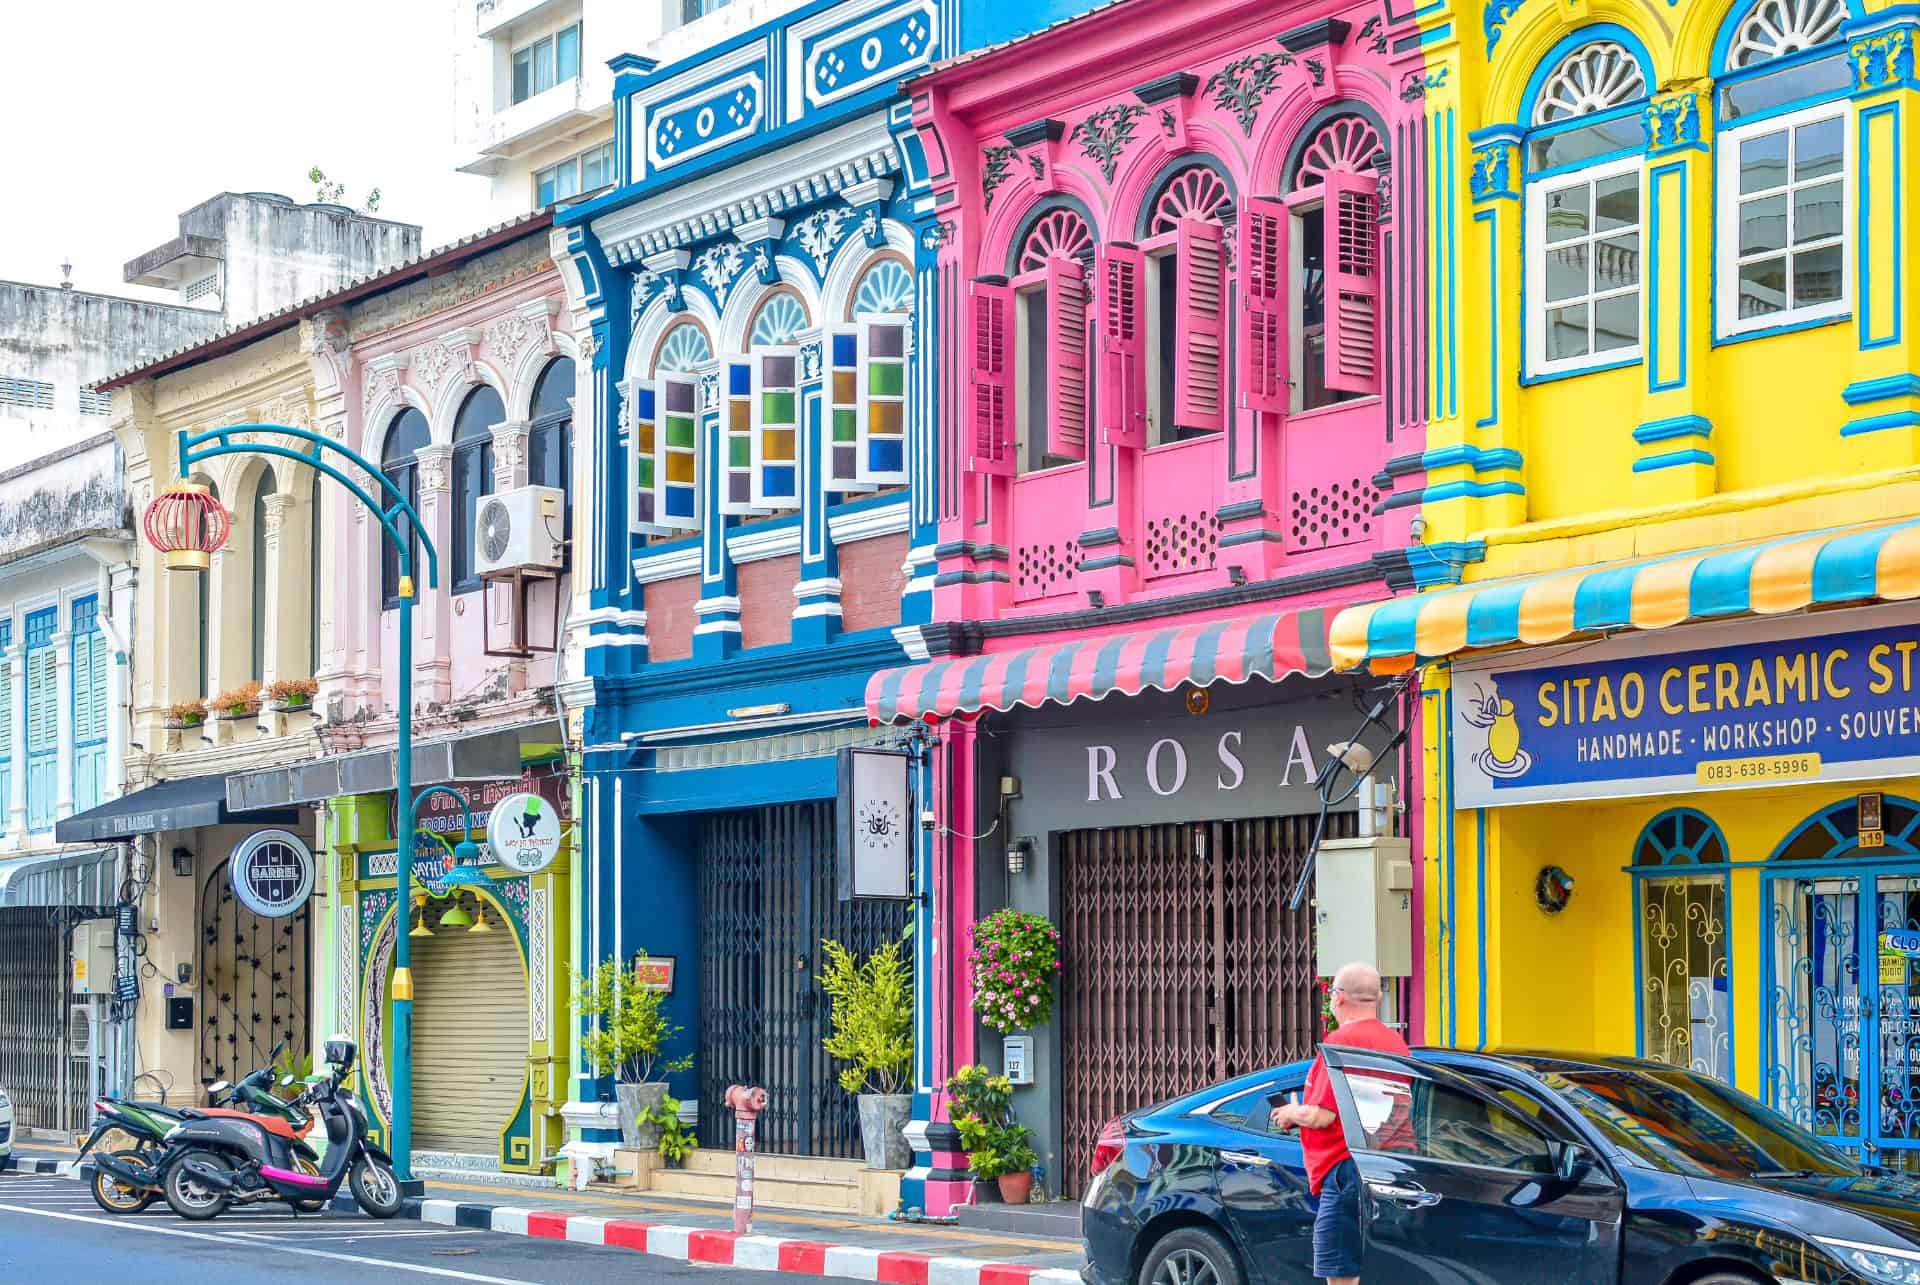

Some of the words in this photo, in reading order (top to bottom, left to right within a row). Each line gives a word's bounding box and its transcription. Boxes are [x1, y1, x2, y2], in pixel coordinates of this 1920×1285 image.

[1537, 671, 1645, 728] SITAO
[1659, 649, 1851, 716] CERAMIC
[1576, 728, 1683, 763] HANDMADE
[1702, 716, 1818, 752] WORKSHOP
[1085, 725, 1320, 801] ROSA
[1707, 759, 1809, 780] 083-638-5996
[457, 810, 492, 829] DINKS
[251, 866, 299, 879] BARREL
[1009, 1061, 1020, 1070] 117
